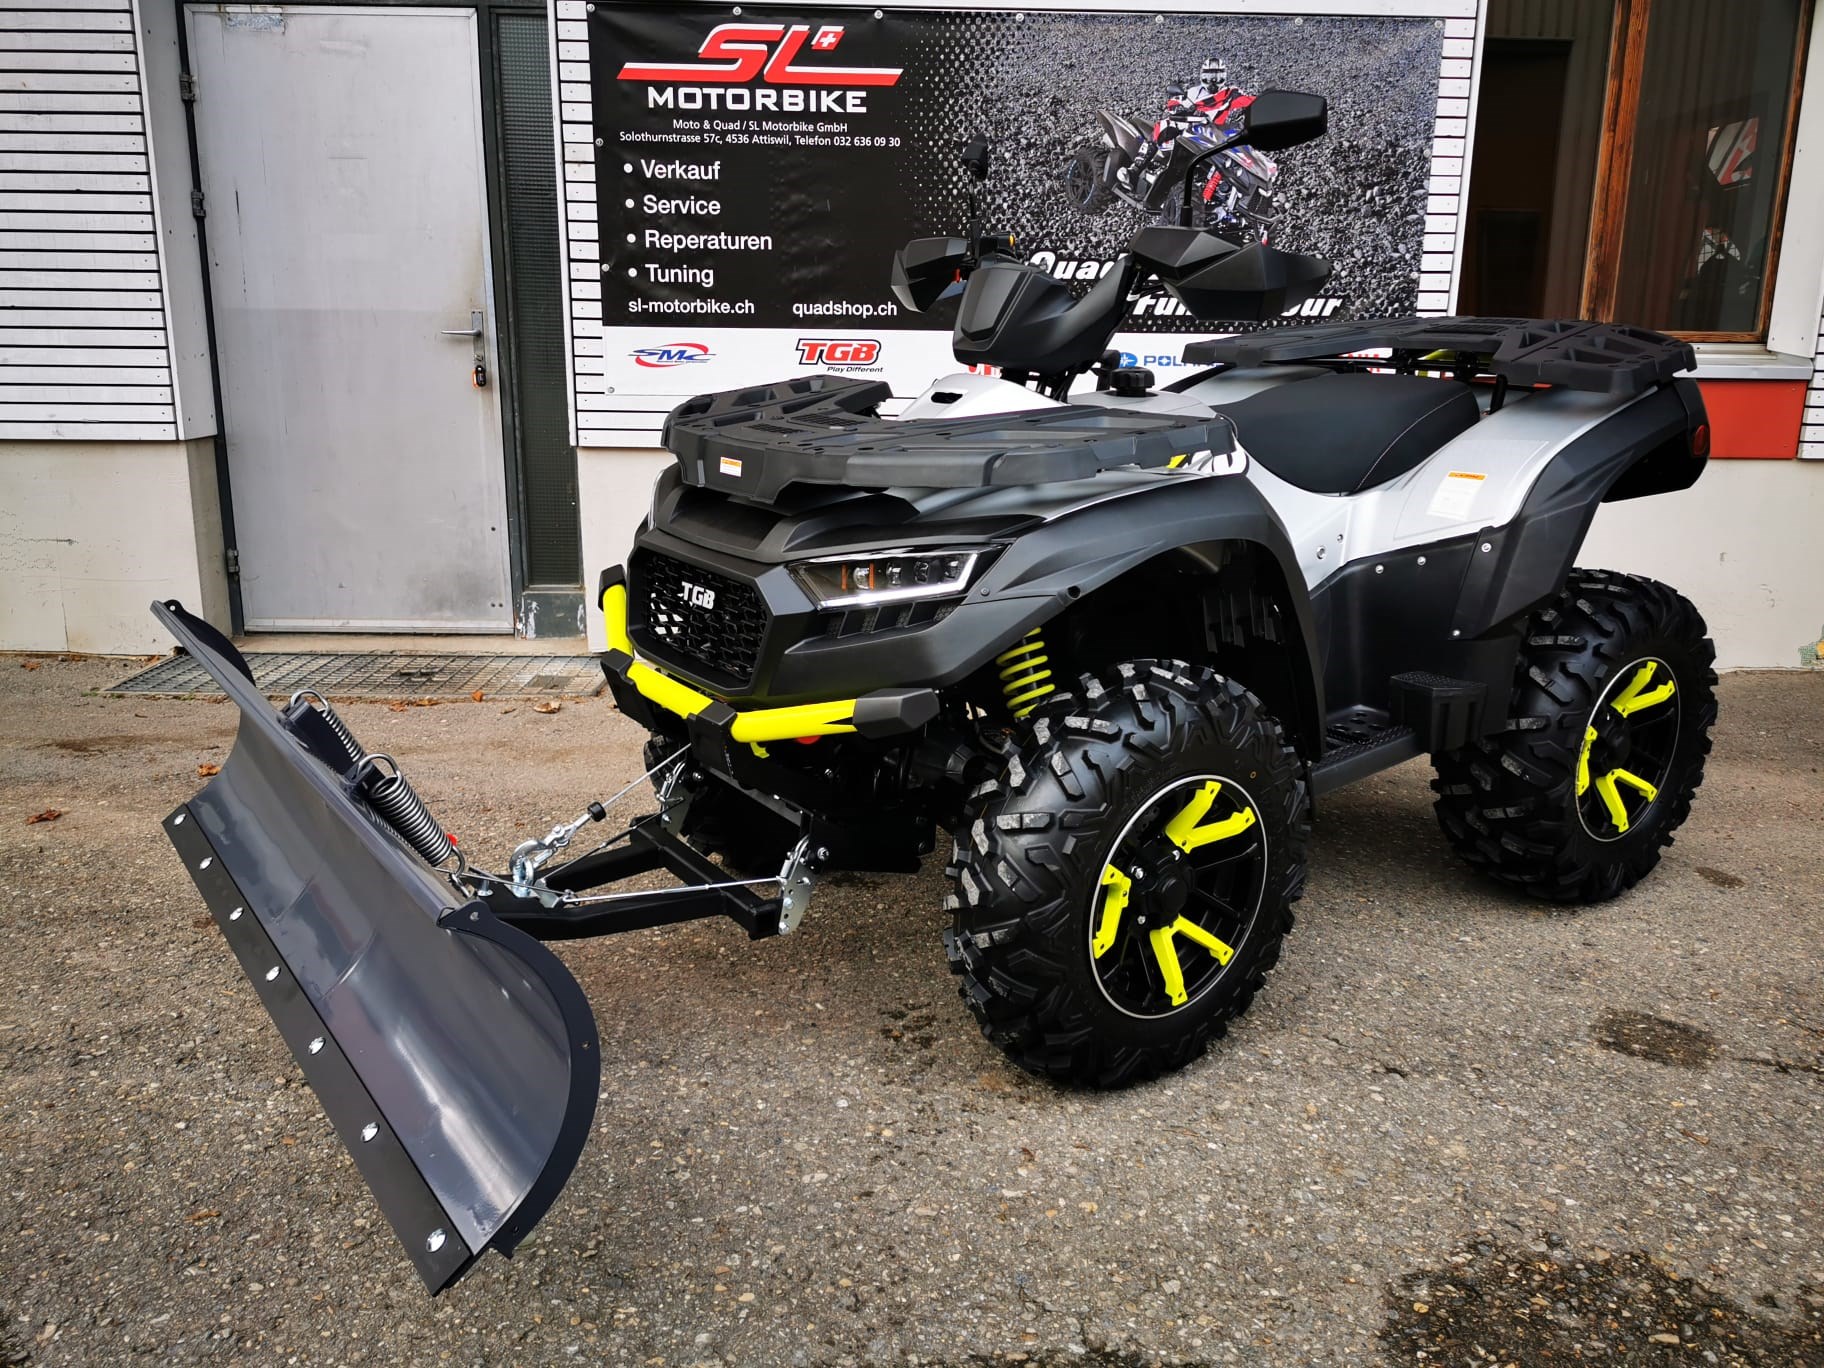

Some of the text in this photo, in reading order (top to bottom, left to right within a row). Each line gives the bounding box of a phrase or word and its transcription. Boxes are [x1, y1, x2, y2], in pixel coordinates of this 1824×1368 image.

[617, 23, 903, 86] SL
[647, 86, 868, 113] MOTORBIKE
[672, 119, 848, 133] Moto & Quad / SL Motorbike GmbH
[619, 131, 901, 147] Solothurnstrasse 57c, 4536 Attiswil, Telefon 032 636 09 30
[640, 159, 721, 180] Verkauf
[642, 195, 721, 216] Service
[645, 230, 773, 252] Reperaturen
[645, 264, 714, 287] Tuning
[628, 298, 897, 318] sl-motorbike.ch quadshop.ch
[799, 341, 879, 363] TGB
[681, 581, 715, 609] TGB
